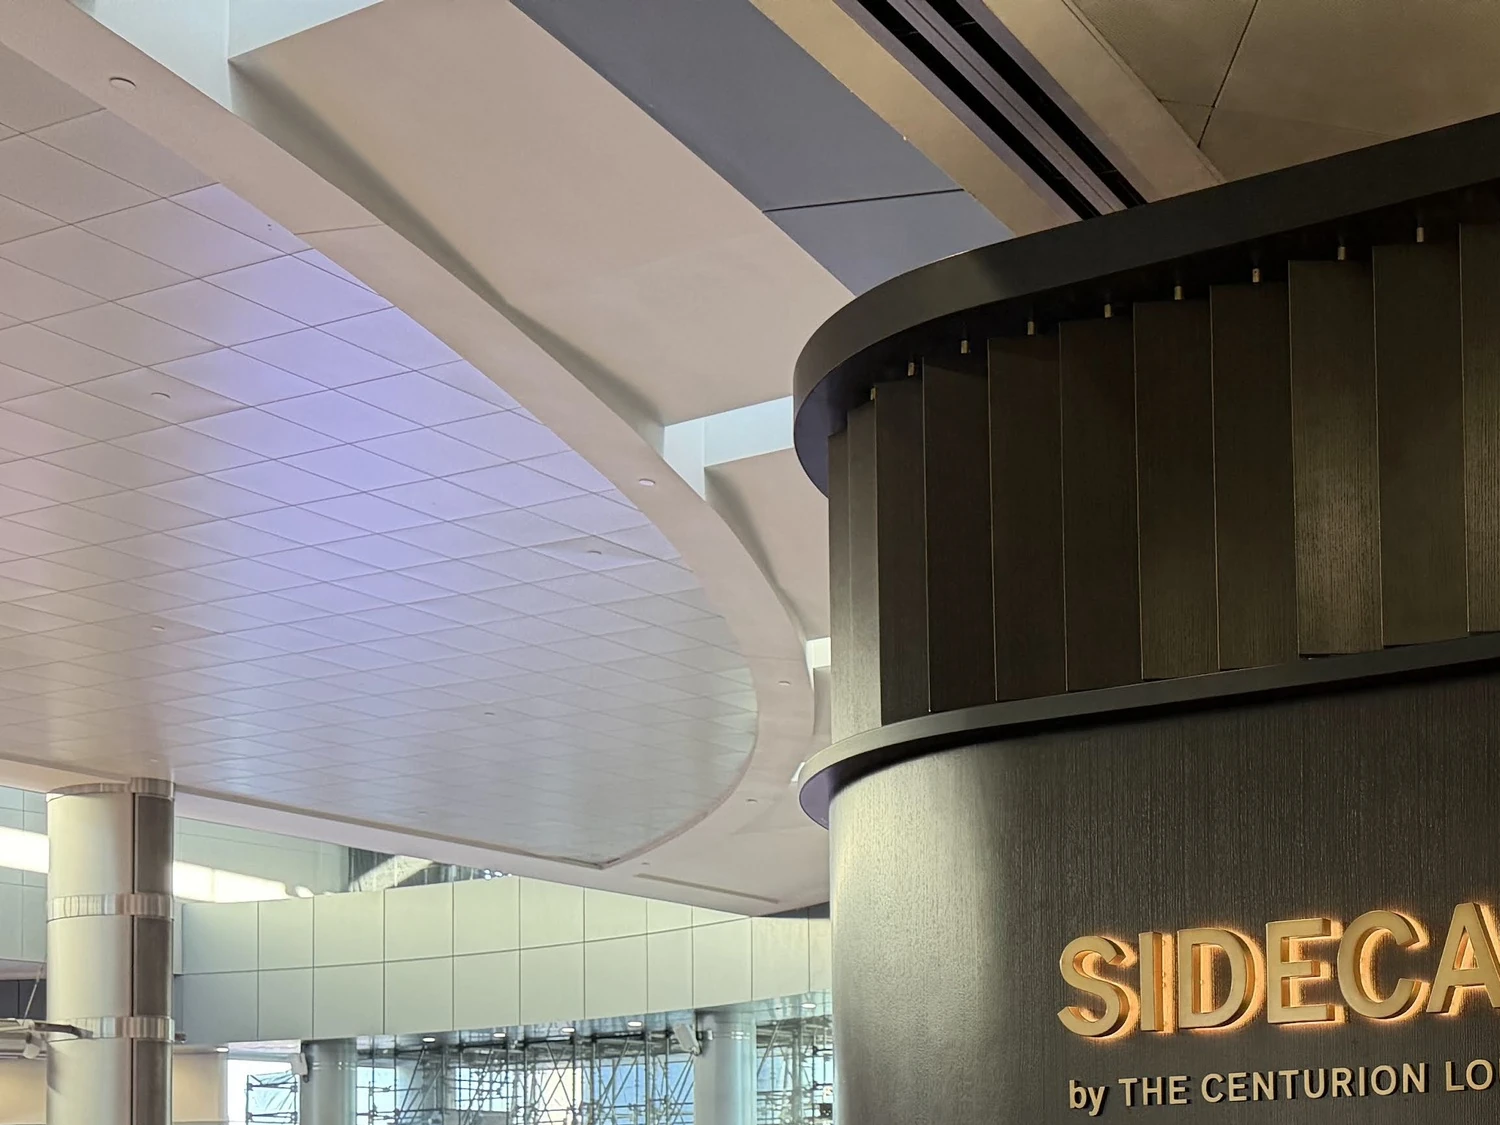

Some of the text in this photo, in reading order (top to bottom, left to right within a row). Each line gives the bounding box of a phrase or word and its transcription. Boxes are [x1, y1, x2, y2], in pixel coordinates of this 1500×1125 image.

[1069, 1079, 1108, 1116] by
[1118, 1075, 1189, 1107] THE
[1200, 1062, 1428, 1104] CENTURION
